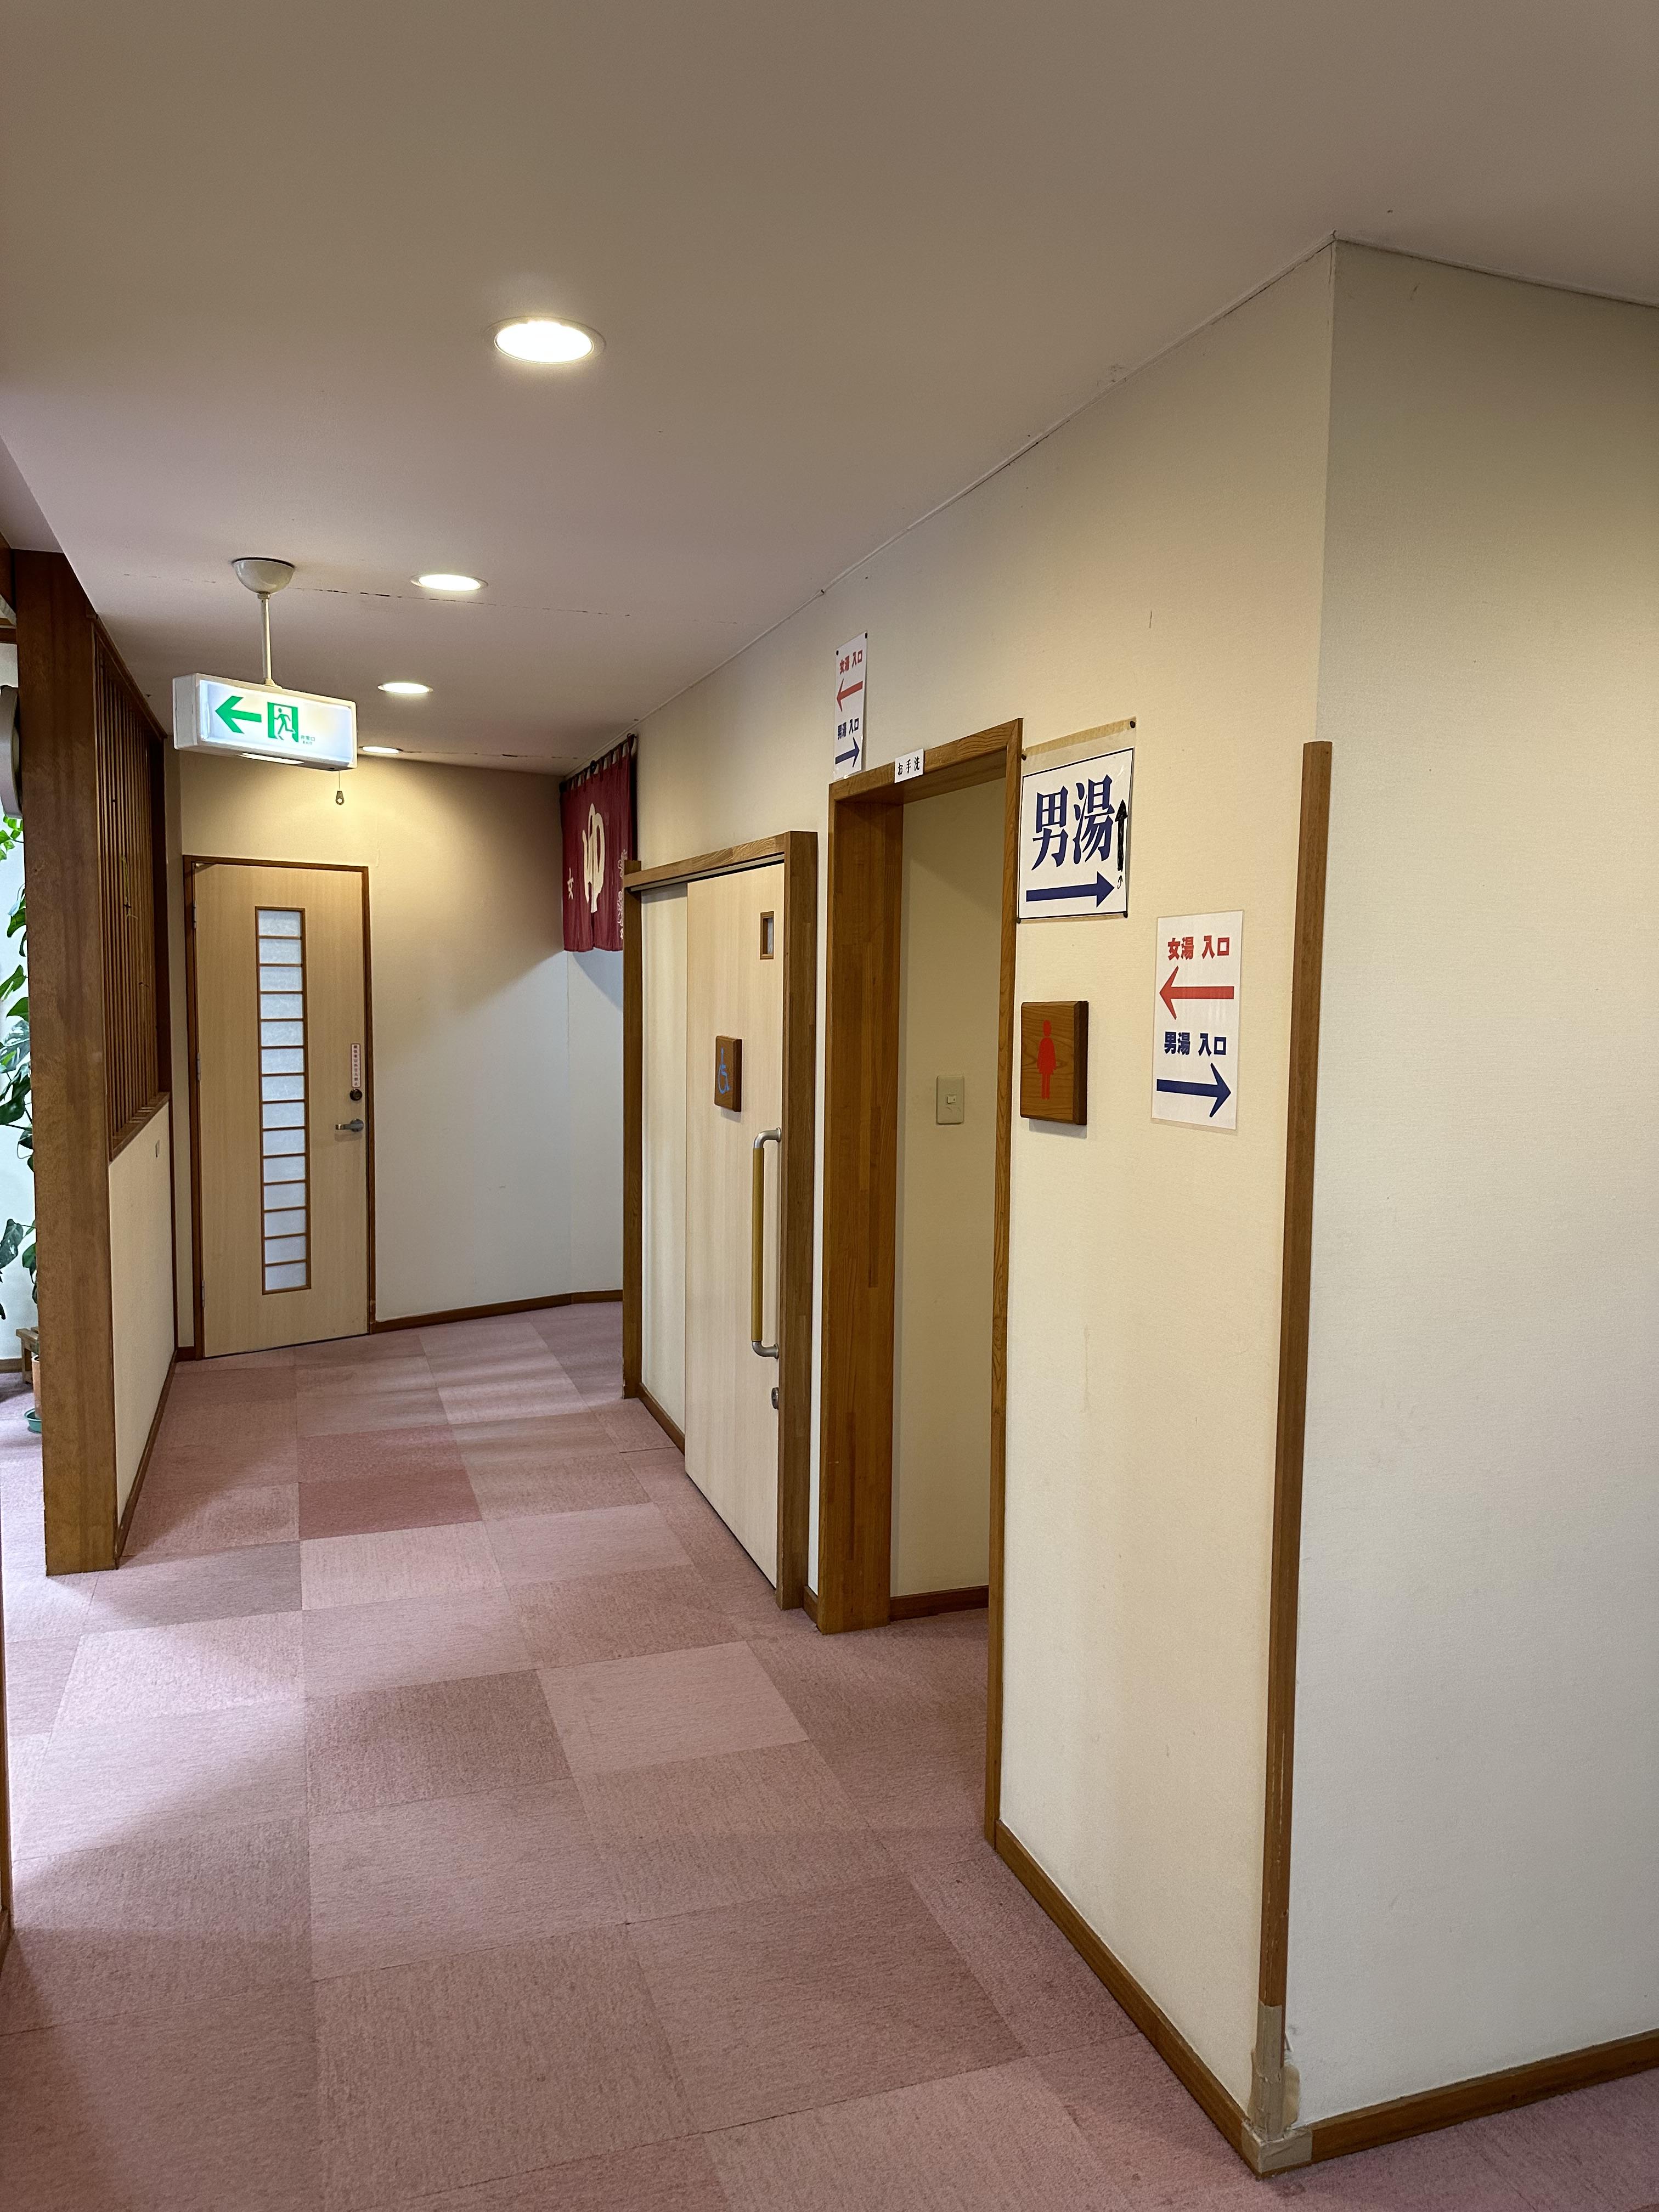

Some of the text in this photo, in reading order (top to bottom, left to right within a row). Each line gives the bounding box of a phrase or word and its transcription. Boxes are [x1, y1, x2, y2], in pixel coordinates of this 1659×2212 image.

[839, 650, 863, 675] 女湯 入口
[838, 718, 859, 740] 男湯 入口
[898, 756, 920, 776] お手洗
[1031, 774, 1115, 871] 男湯
[582, 803, 605, 913] ゆ
[1168, 935, 1230, 961] 女湯 入口
[1164, 1031, 1227, 1056] 男湯 入口
